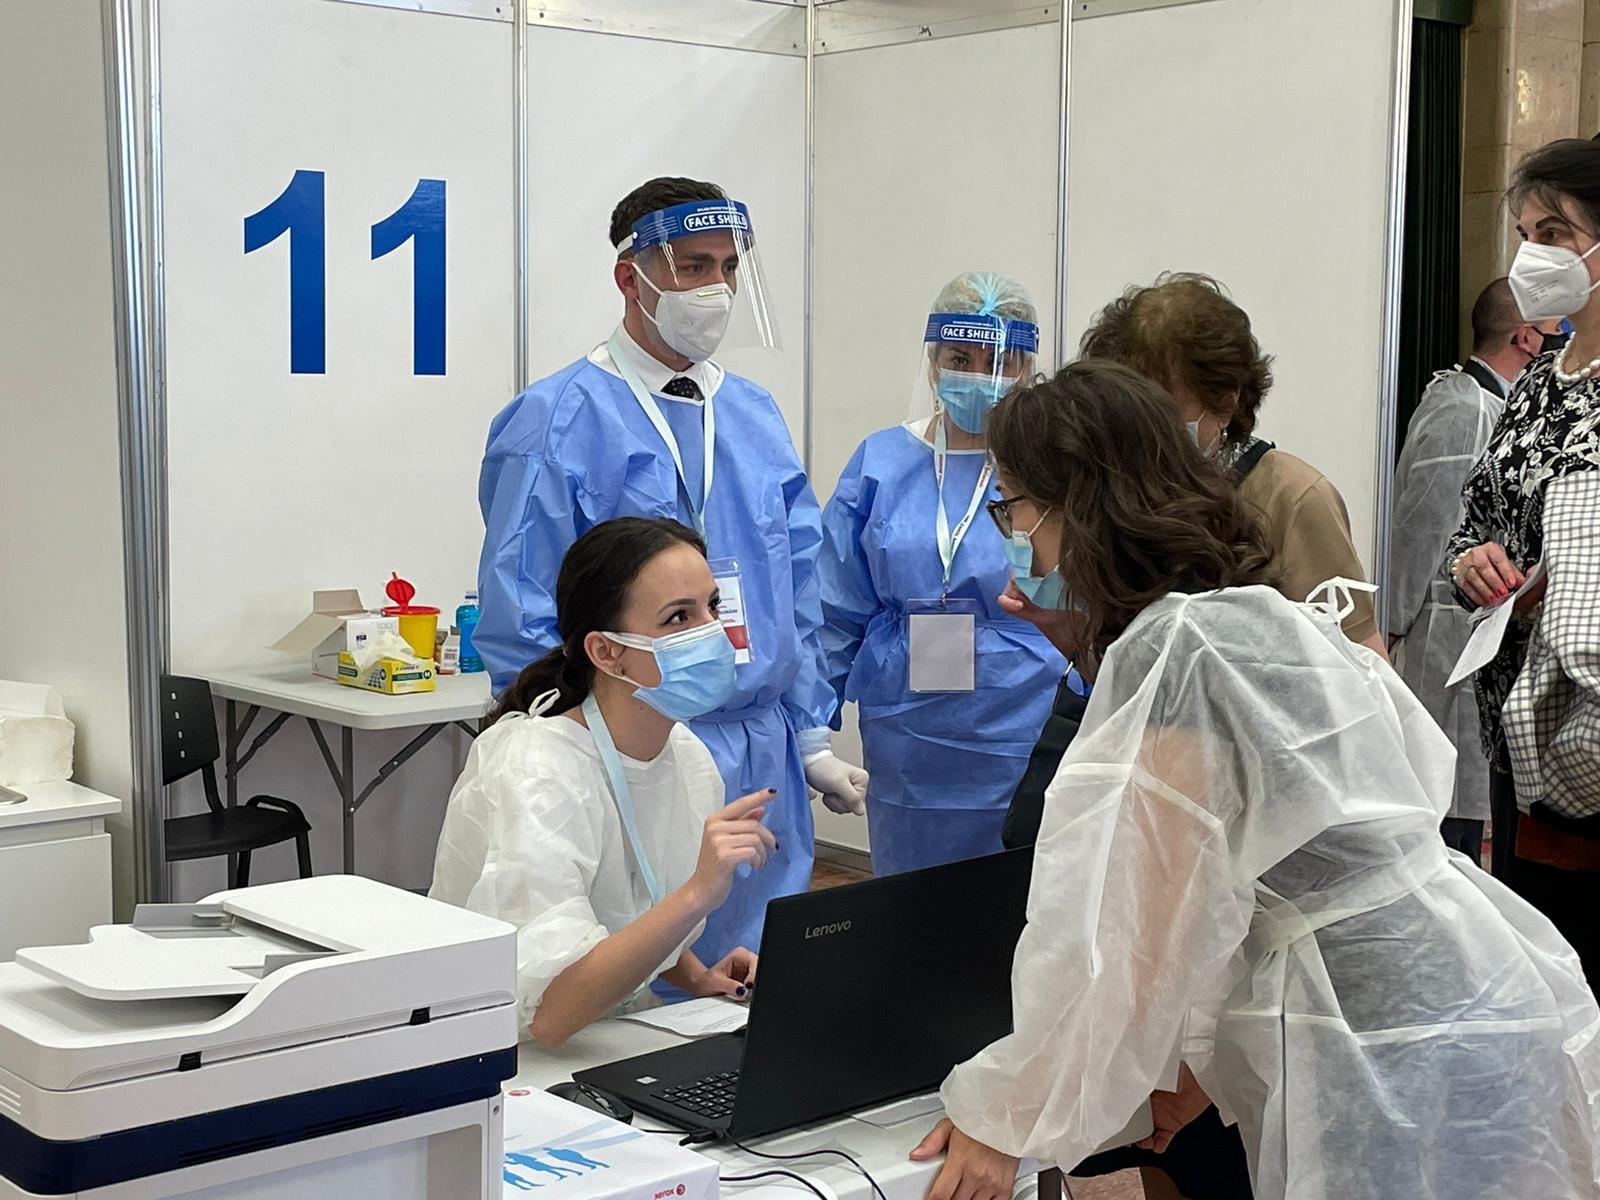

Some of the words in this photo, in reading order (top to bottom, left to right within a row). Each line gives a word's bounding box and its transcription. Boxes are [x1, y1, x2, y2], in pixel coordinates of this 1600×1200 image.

[688, 215, 716, 228] FACE
[719, 213, 747, 226] SHIELD
[244, 169, 446, 376] 11
[943, 327, 965, 338] FACE
[967, 329, 1003, 341] SHIELD
[804, 920, 852, 939] Lenovo
[655, 1188, 674, 1200] xerox
